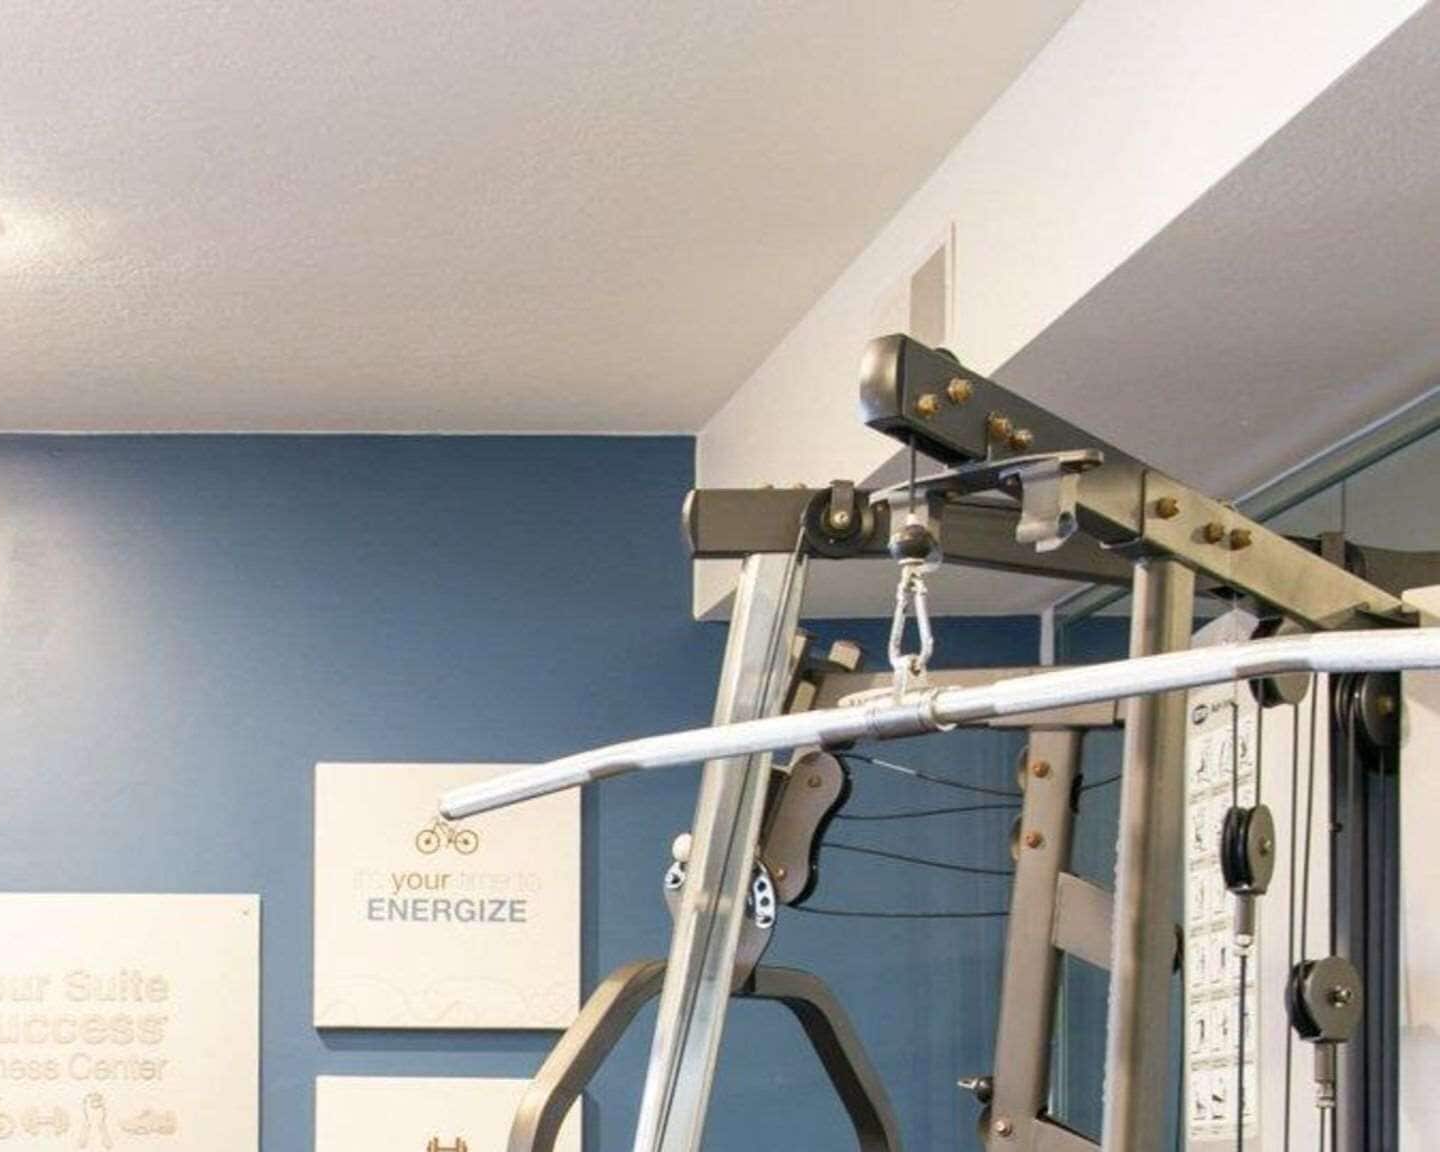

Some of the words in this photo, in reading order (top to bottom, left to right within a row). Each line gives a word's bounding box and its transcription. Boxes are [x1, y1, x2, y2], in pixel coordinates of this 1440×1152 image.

[390, 872, 452, 896] your
[366, 897, 528, 923] ENERGIZE
[62, 967, 171, 1003] Suite
[68, 1051, 170, 1082] Center
